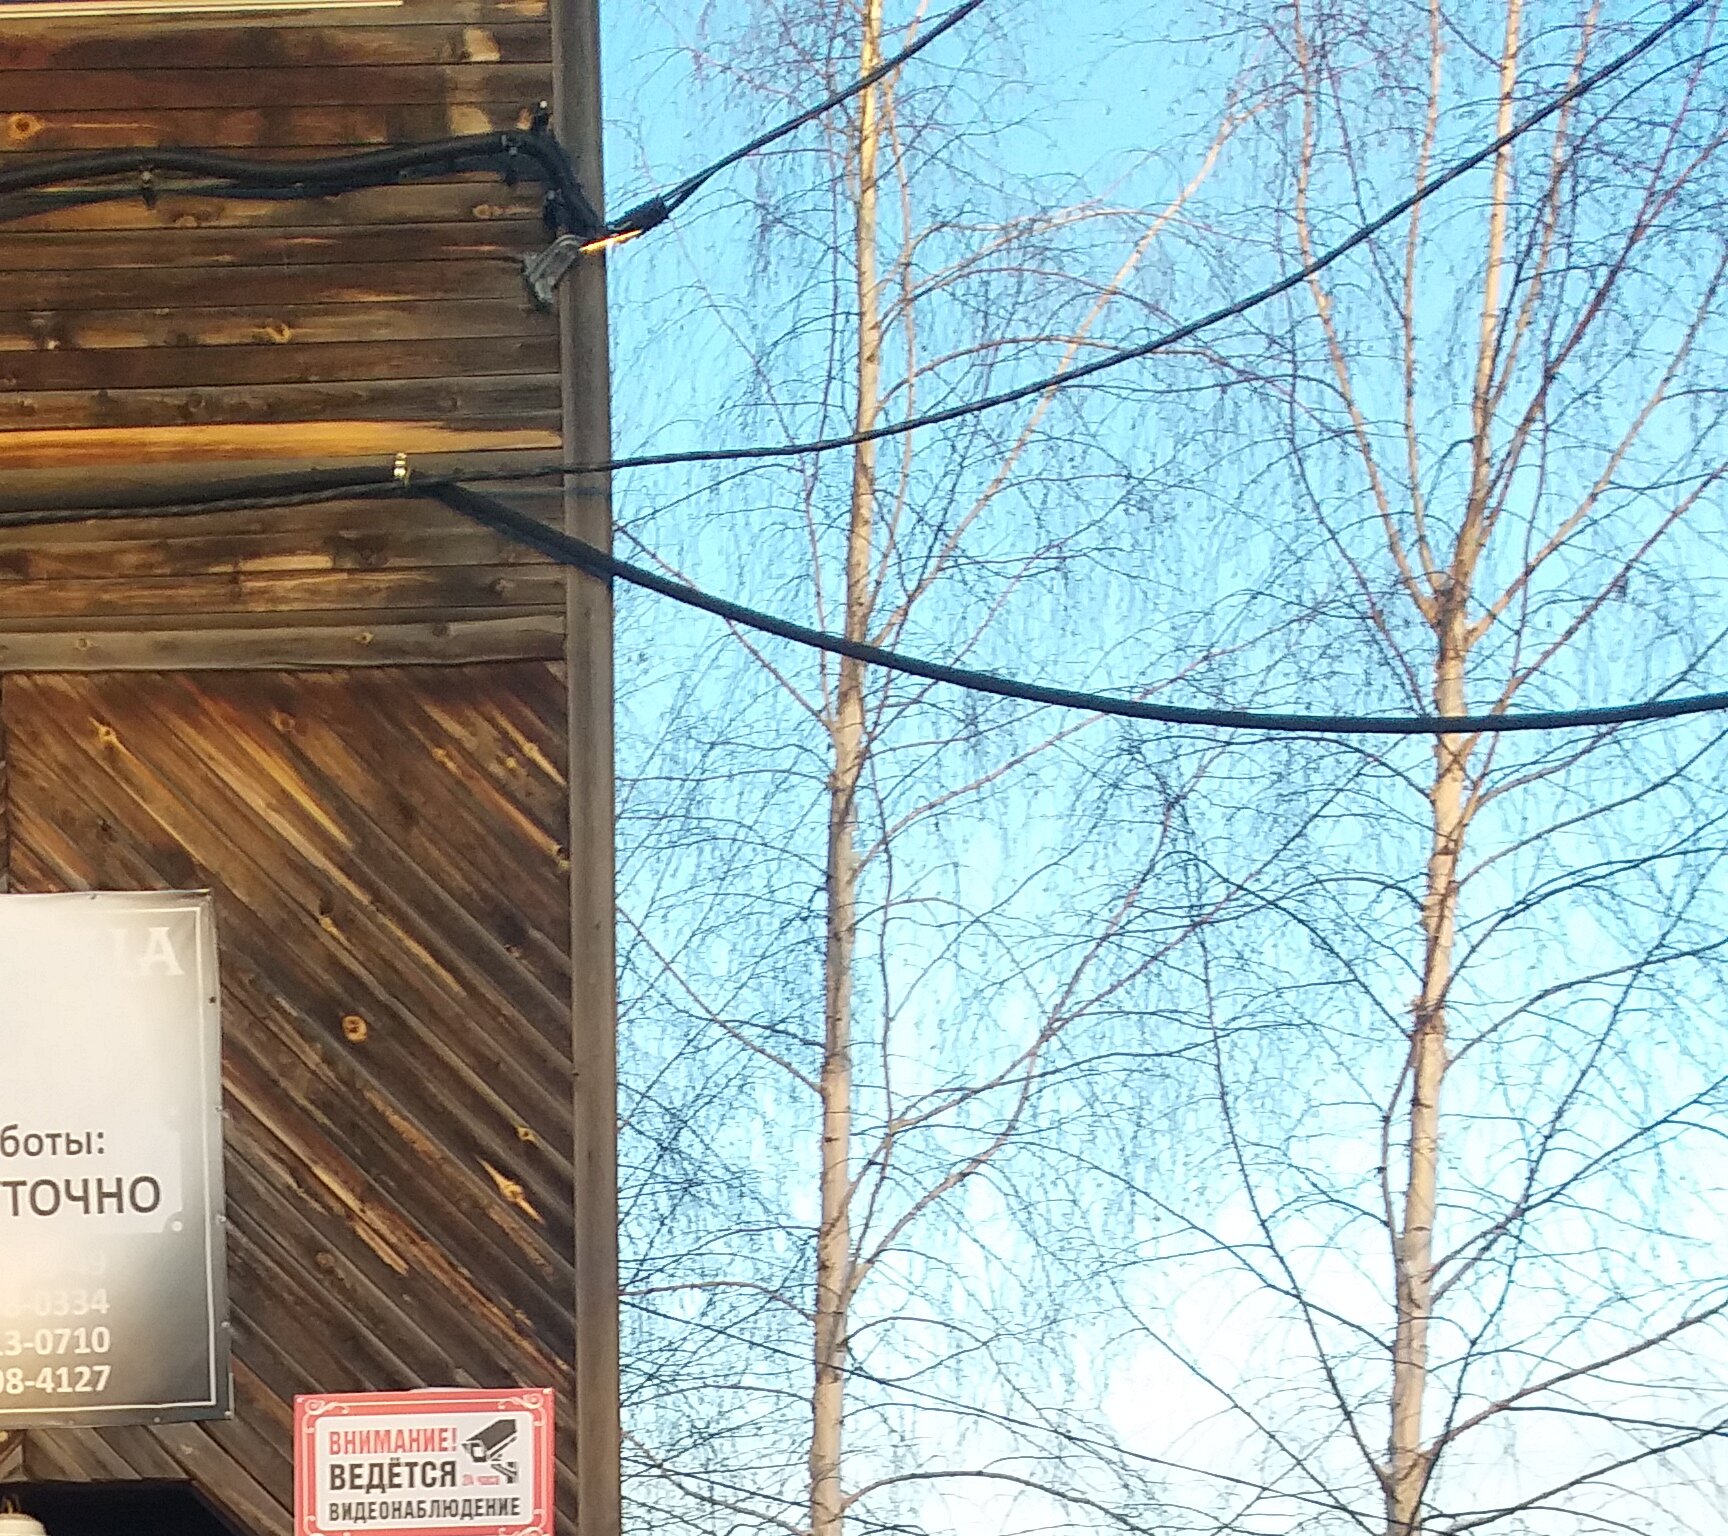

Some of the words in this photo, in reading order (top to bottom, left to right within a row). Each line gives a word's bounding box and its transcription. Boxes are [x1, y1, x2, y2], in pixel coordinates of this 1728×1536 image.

[329, 1427, 458, 1456] ВНИМАНИЕ!
[329, 1457, 456, 1494] ВЕДЁТСЯ
[329, 1497, 521, 1523] ВИДЕОНАБЛЮДЕНИЕ
